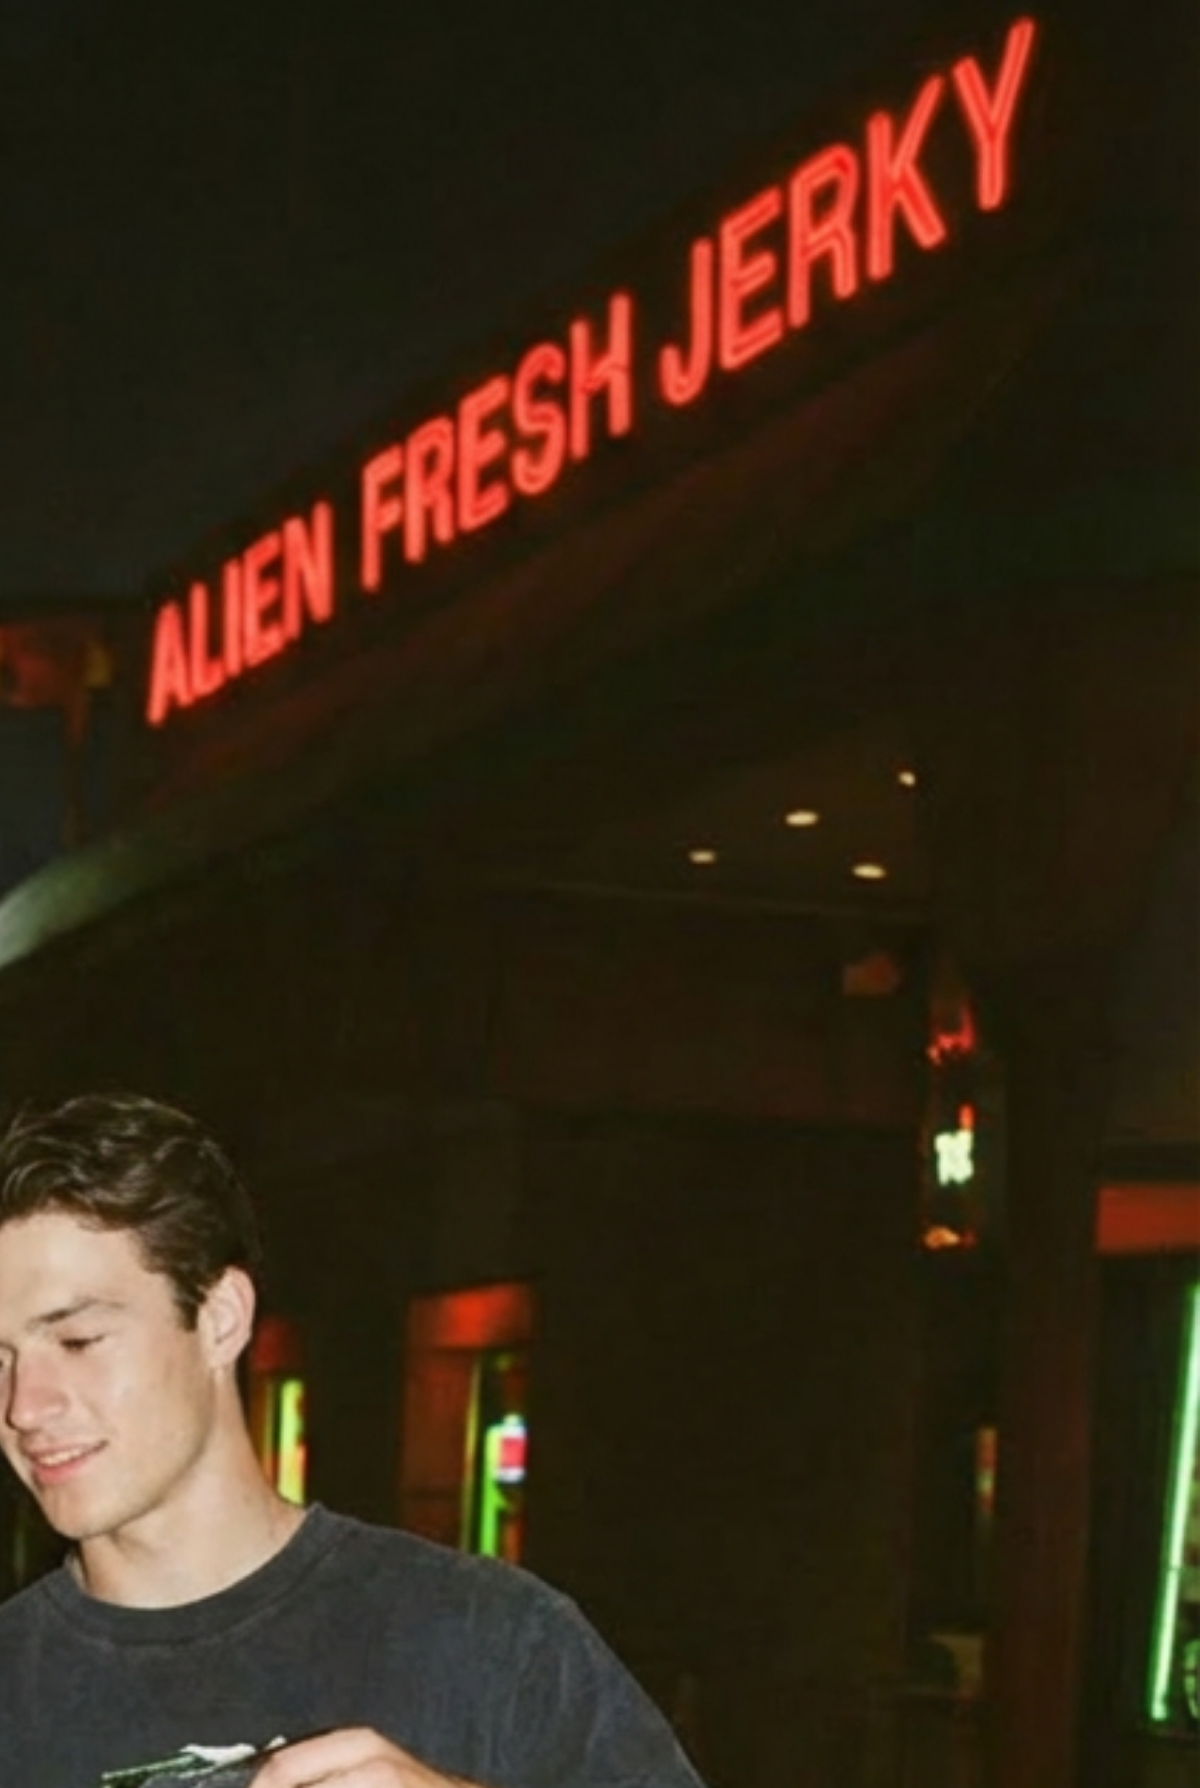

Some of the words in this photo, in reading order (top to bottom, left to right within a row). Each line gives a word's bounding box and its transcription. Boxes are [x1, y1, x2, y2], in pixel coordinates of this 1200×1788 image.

[147, 503, 333, 725] ALIEN
[360, 293, 631, 591] FRESH
[659, 18, 1034, 405] JERKY
